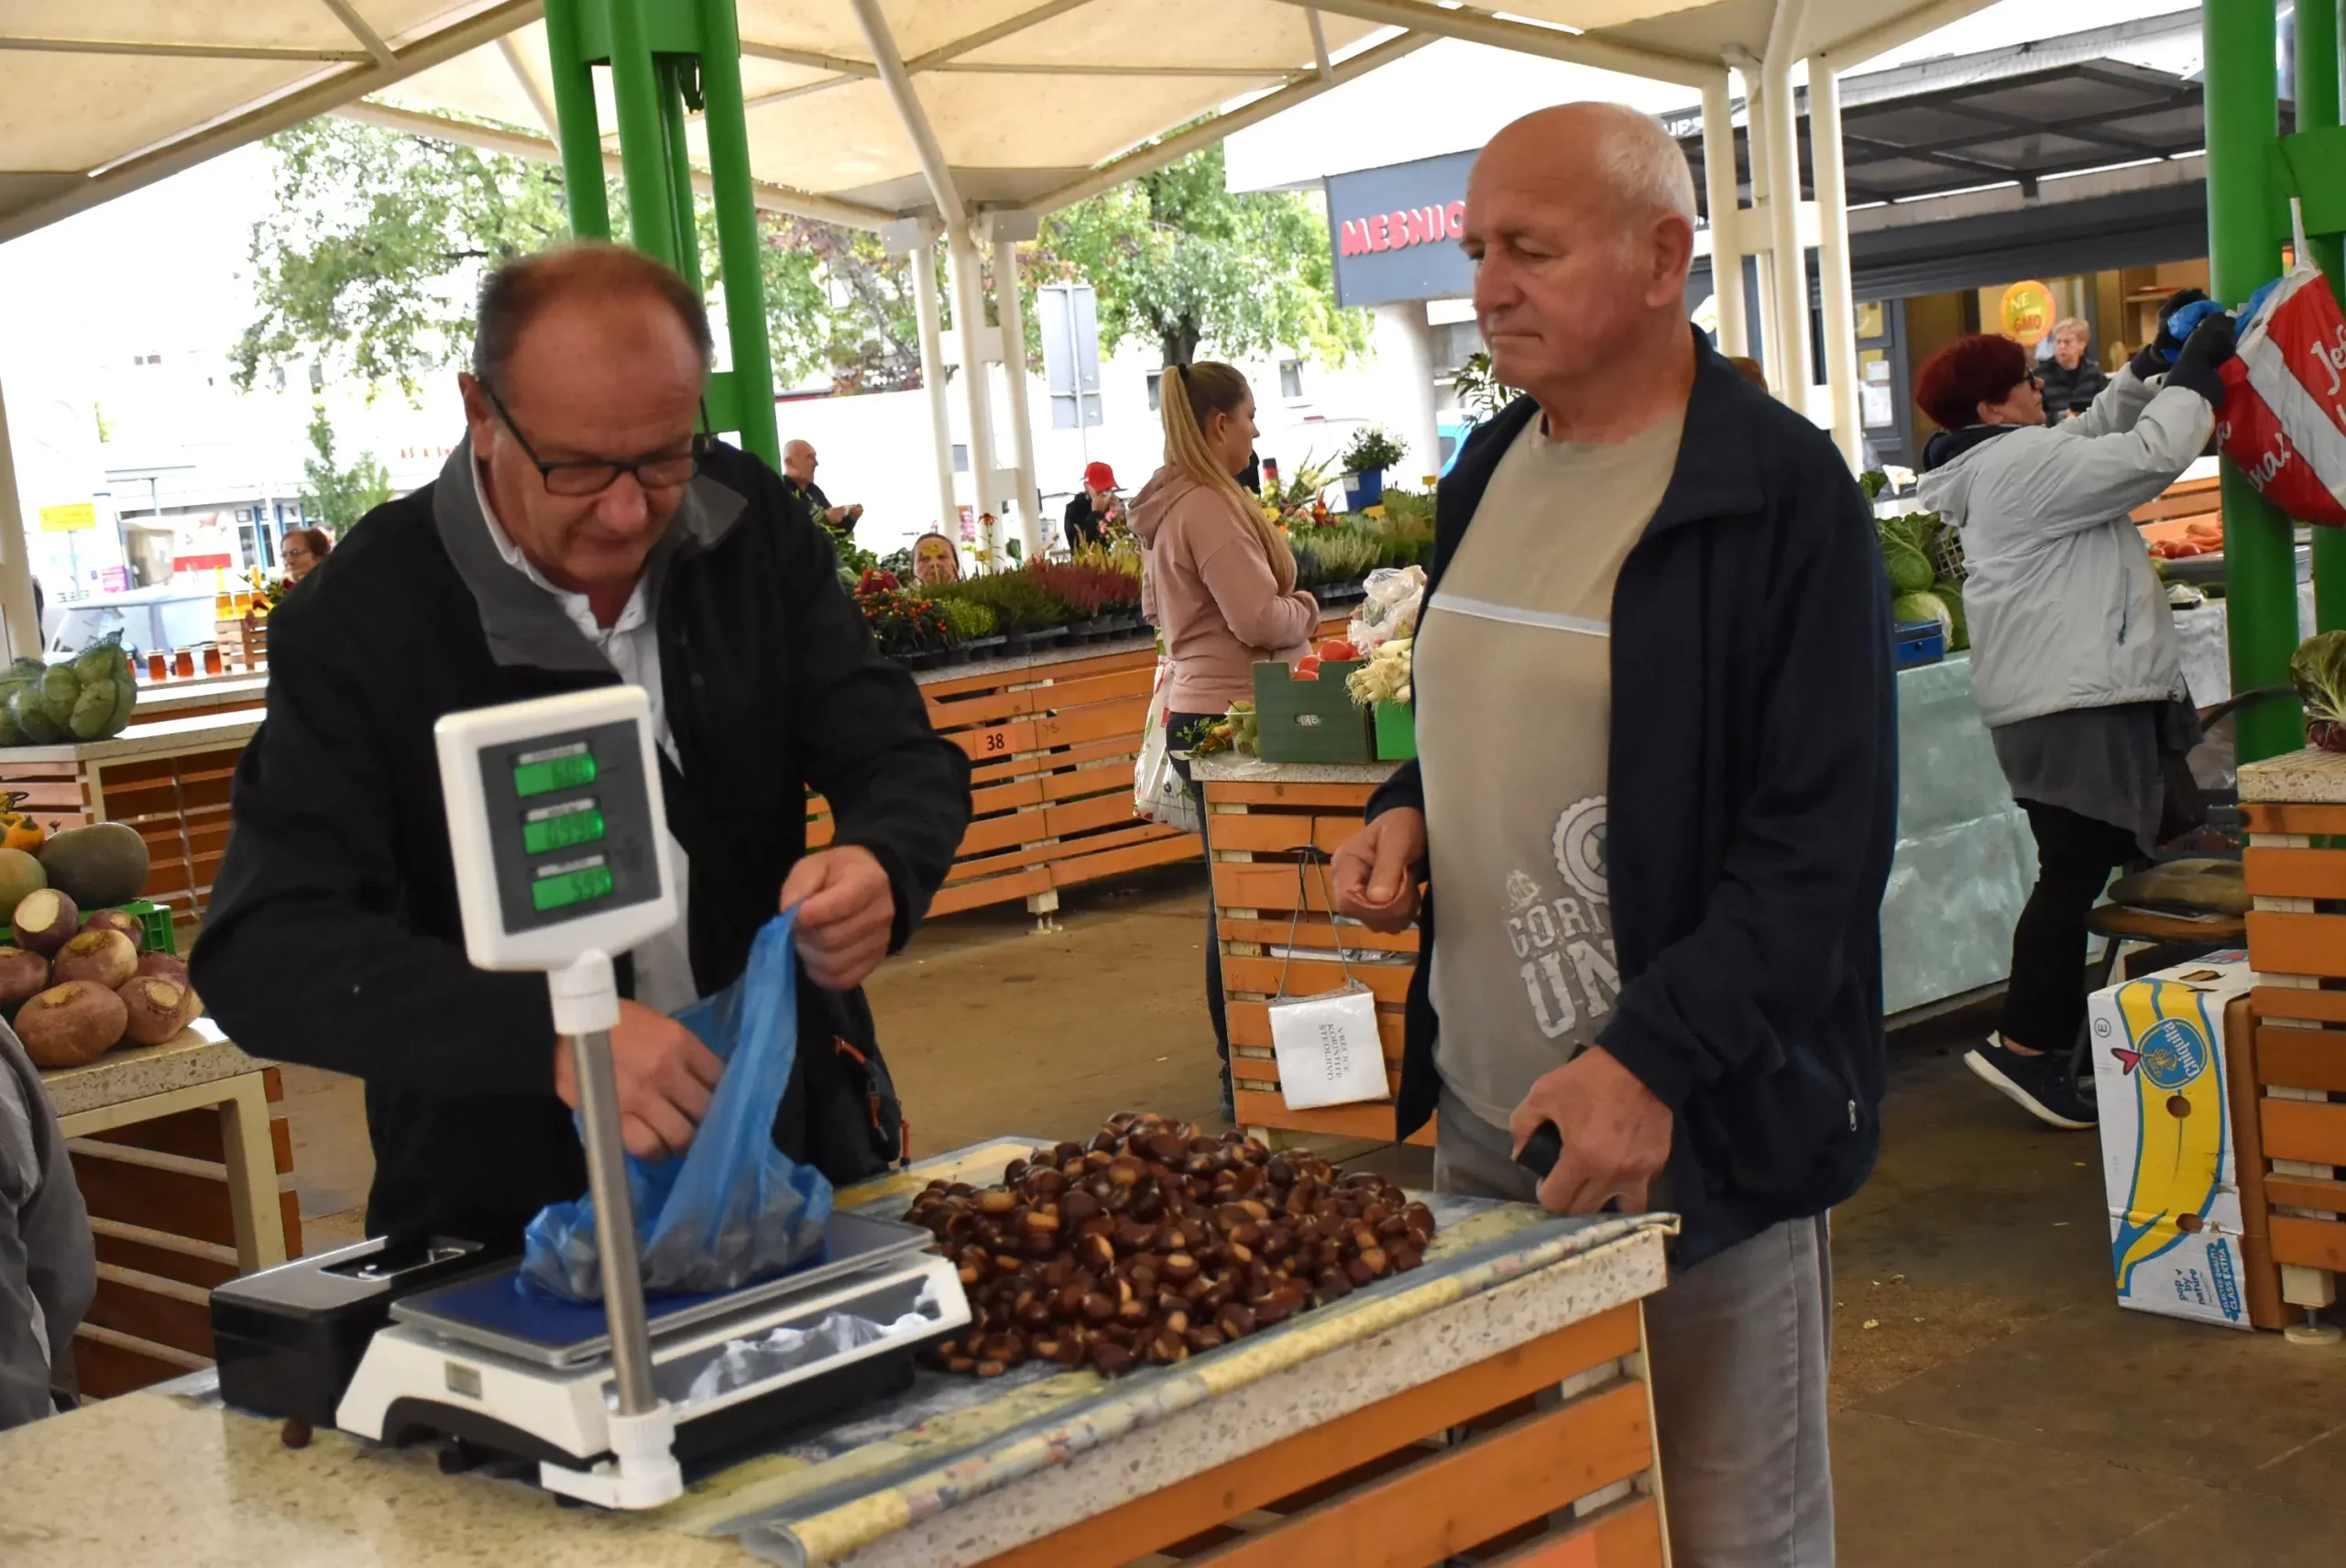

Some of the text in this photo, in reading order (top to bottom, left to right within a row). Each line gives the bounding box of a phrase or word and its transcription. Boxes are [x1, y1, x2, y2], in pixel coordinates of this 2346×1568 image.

[986, 733, 1004, 751] 38
[2163, 1021, 2200, 1078] Chiquita
[2175, 1279, 2189, 1301] pop
[2183, 1277, 2194, 1292] by
[2189, 1268, 2206, 1305] nature
[2218, 1247, 2239, 1311] CLASS EXTRA
